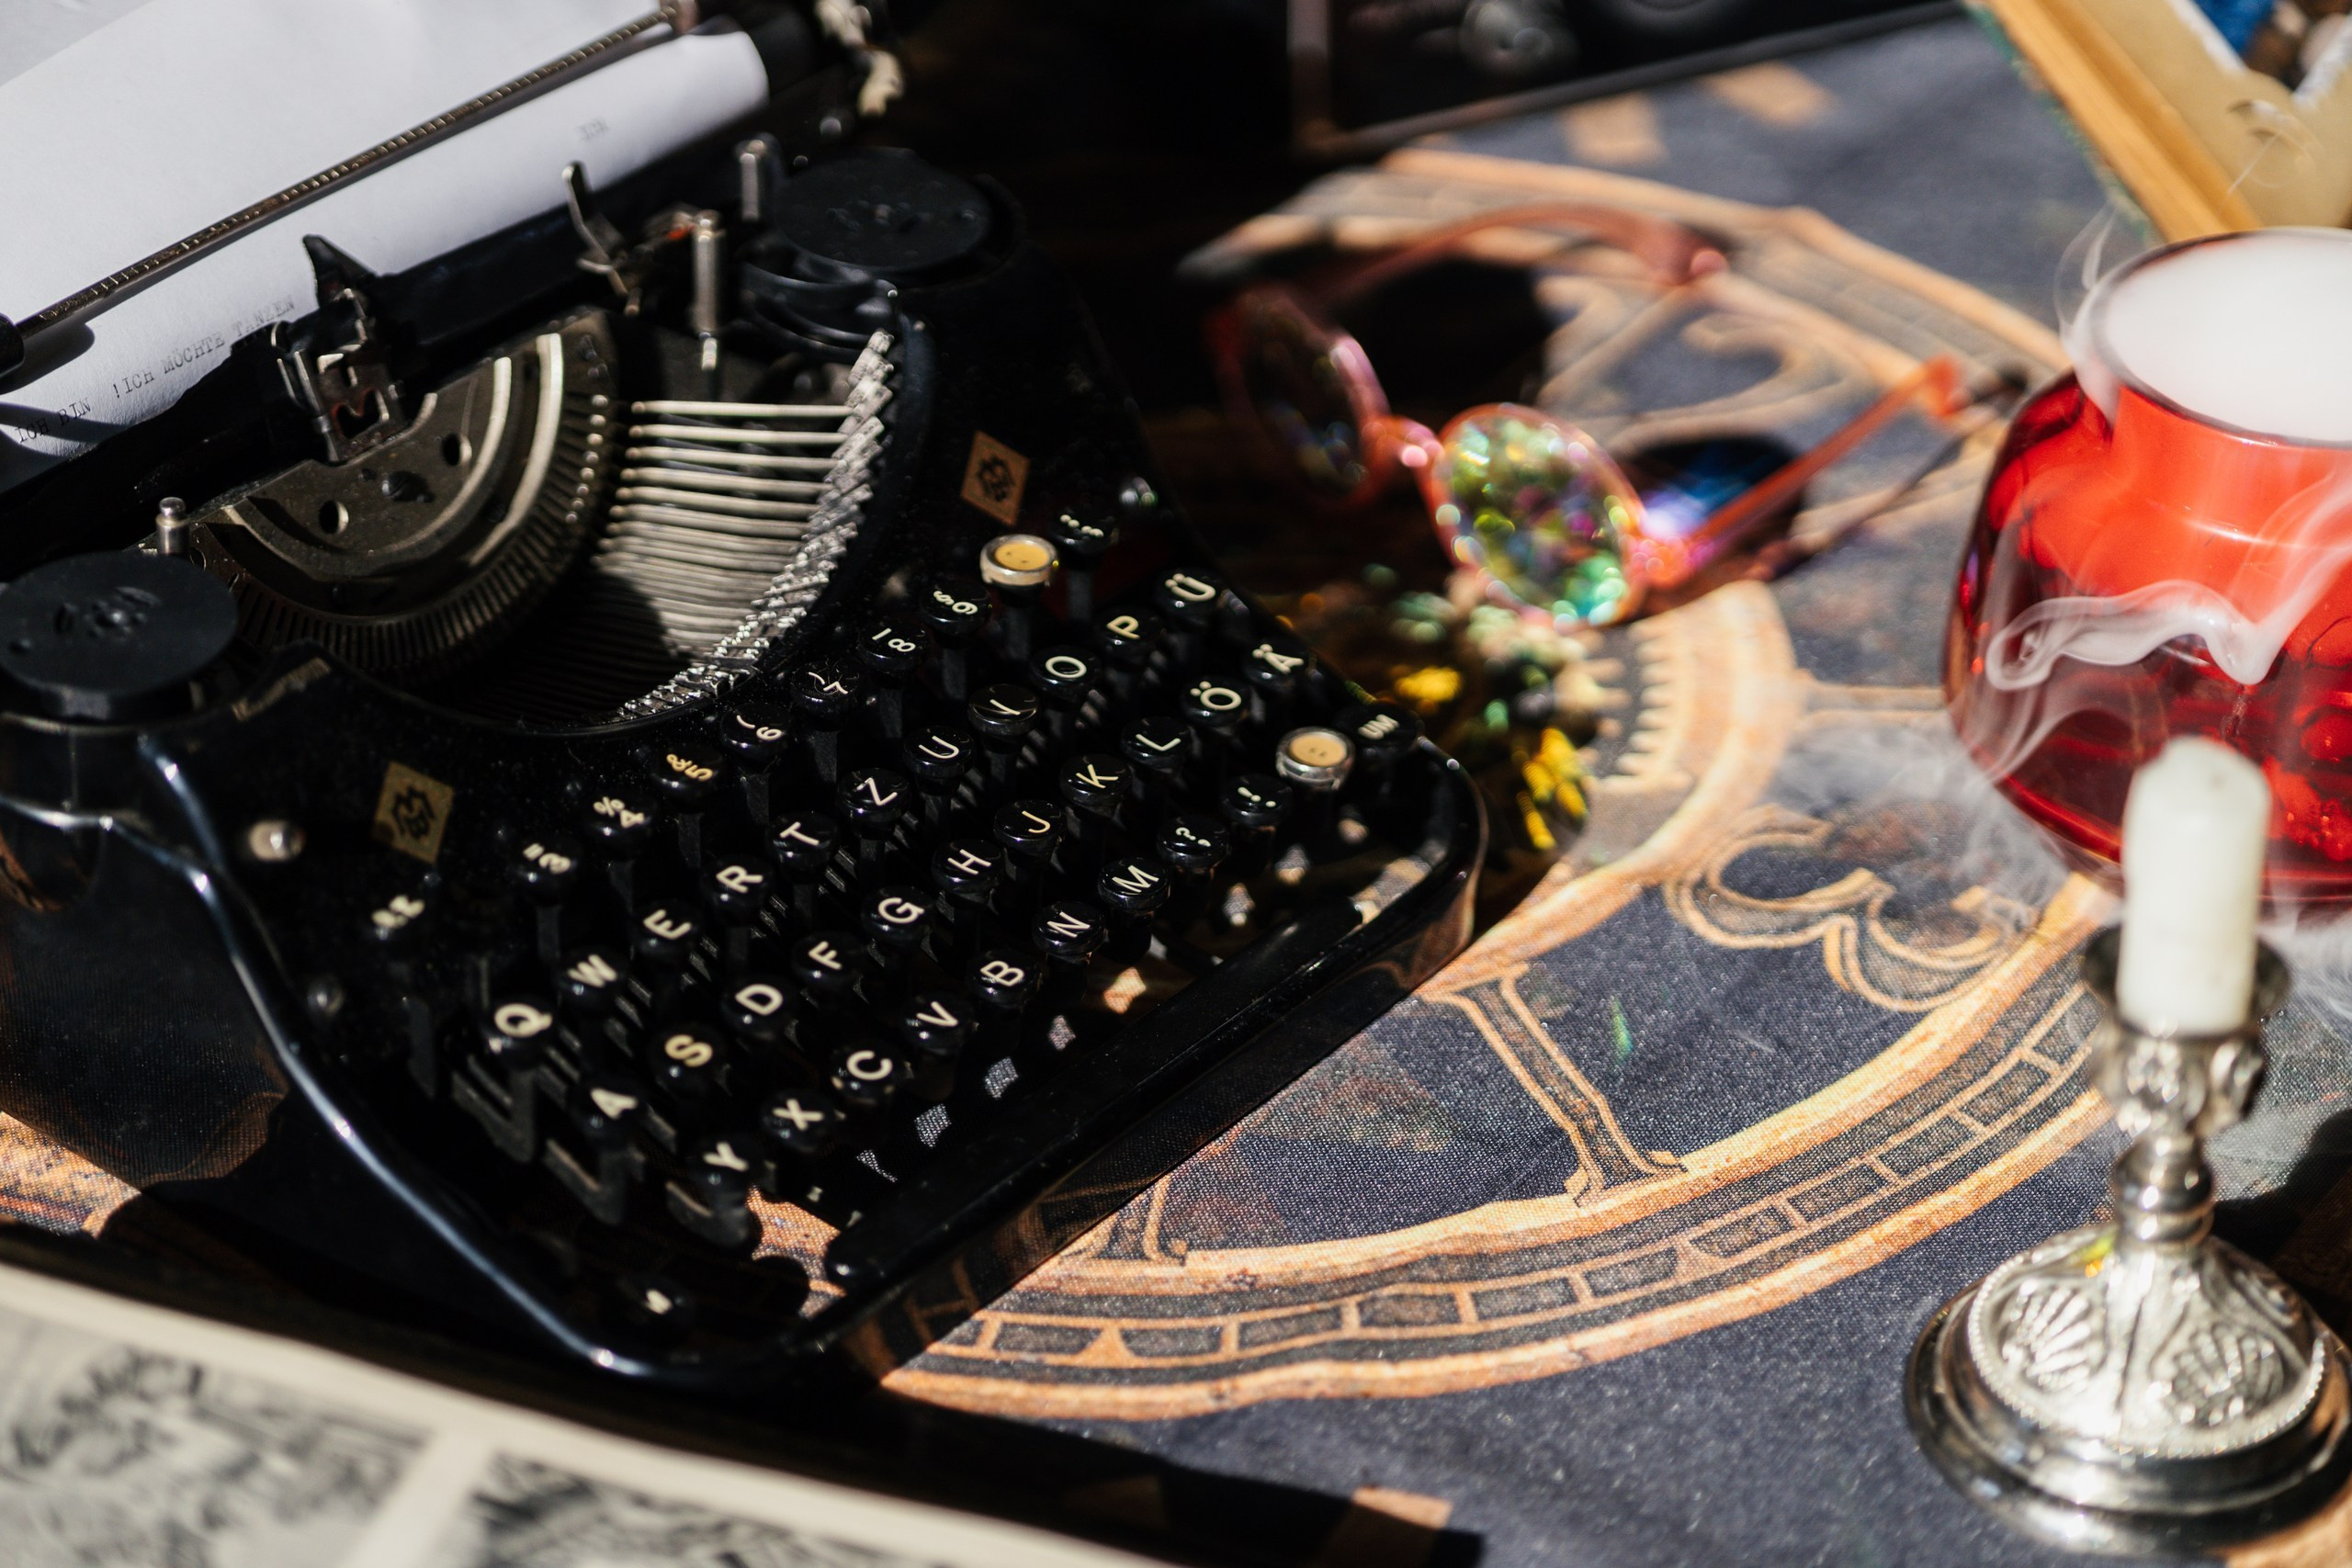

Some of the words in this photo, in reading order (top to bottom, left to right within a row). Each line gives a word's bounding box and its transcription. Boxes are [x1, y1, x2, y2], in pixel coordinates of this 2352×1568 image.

[15, 416, 50, 443] ICH
[58, 397, 92, 427] BIN
[164, 332, 226, 374] MÖCHTE
[1166, 572, 1216, 602] Ü
[951, 599, 978, 615] 9
[1106, 615, 1139, 639] P
[888, 637, 916, 652] 8
[1252, 643, 1304, 673] Ä
[1045, 655, 1087, 679] O
[989, 699, 1022, 716] I
[1190, 681, 1242, 711] Ö
[756, 726, 783, 740] 6
[1136, 733, 1182, 751] L
[918, 735, 960, 760] U
[684, 761, 713, 781] 5
[1076, 763, 1119, 789] K
[856, 776, 898, 807] Z
[594, 796, 625, 817] %
[619, 809, 644, 828] 4
[779, 821, 820, 846] T
[1021, 810, 1051, 834] J
[538, 852, 571, 873] 3
[947, 849, 992, 875] H
[716, 865, 763, 894] R
[1112, 864, 1159, 896] M
[877, 897, 925, 924] G
[644, 909, 692, 941] E
[1046, 911, 1091, 938] N
[808, 941, 842, 969] F
[569, 954, 612, 987] W
[981, 960, 1024, 987] B
[736, 984, 783, 1015] D
[494, 1003, 552, 1037] Q
[917, 1001, 958, 1027] V
[666, 1034, 713, 1066] S
[846, 1050, 893, 1080] C
[591, 1089, 636, 1119] A
[774, 1099, 823, 1130] X
[705, 1143, 747, 1170] Y
